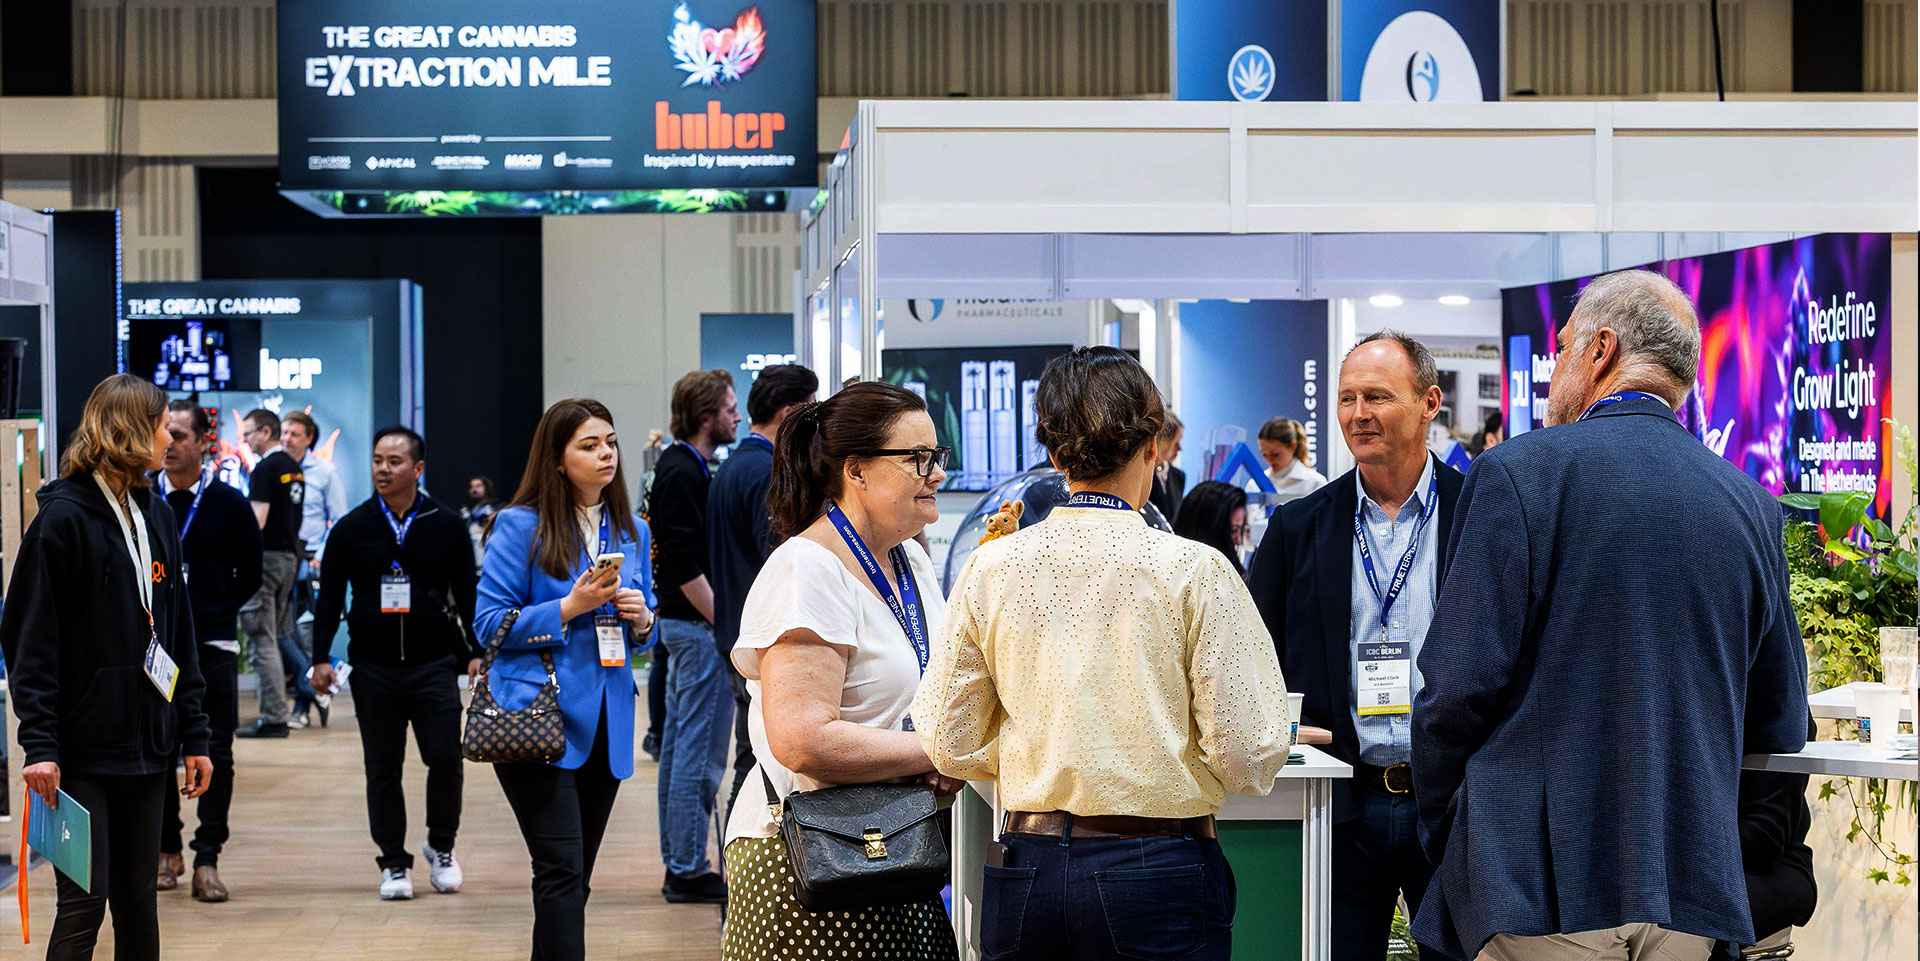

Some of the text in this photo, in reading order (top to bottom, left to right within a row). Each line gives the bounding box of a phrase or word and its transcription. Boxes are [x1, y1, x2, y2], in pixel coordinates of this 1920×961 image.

[322, 25, 577, 48] THE GREAT CANNABIS
[305, 55, 612, 96] EXTRACTION MILE
[655, 100, 785, 150] huber
[644, 154, 796, 170] Inspired by temperature
[128, 298, 301, 315] THE GREAT CANNABIS
[1808, 291, 1876, 345] Redefine
[259, 348, 322, 390] ber
[1793, 358, 1876, 419] Grow Light
[1799, 435, 1876, 467] Designed and made
[1801, 467, 1876, 494] in The Netherlands
[843, 525, 876, 574] trueterpenes.com
[1381, 647, 1402, 655] BERLIN
